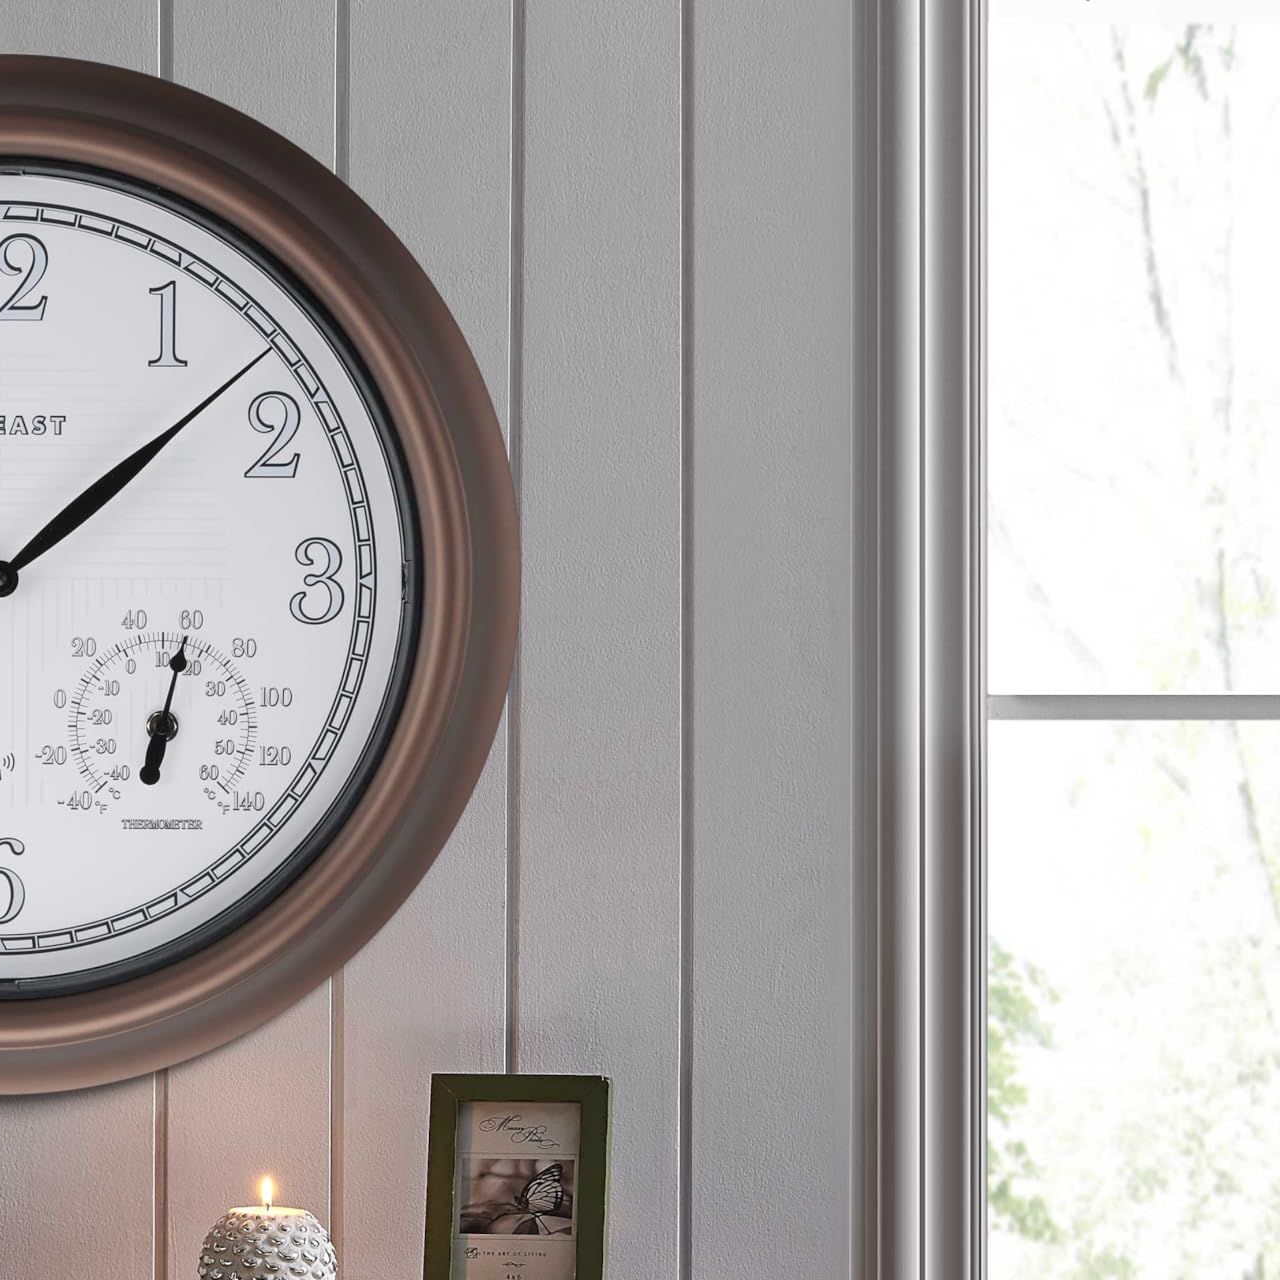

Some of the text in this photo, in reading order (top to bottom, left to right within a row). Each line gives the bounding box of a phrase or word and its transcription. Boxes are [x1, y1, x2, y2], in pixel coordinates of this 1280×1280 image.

[148, 281, 189, 367] 1
[245, 391, 302, 478] 2
[289, 537, 345, 624] 3
[121, 609, 147, 630] 40
[179, 609, 204, 630] 60
[71, 636, 97, 658] 20
[231, 638, 258, 658] 80
[125, 658, 137, 675] 0
[155, 651, 171, 668] 10
[182, 659, 202, 677] 20
[97, 679, 120, 696] -10
[205, 680, 226, 697] 30
[259, 687, 293, 708] 100
[53, 688, 67, 709] 0
[86, 709, 113, 725] -20
[217, 709, 238, 726] 40
[34, 745, 68, 766] -20
[89, 738, 117, 755] -30
[215, 739, 235, 756] 50
[258, 746, 292, 766] 120
[103, 764, 131, 781] -40
[199, 764, 220, 781] 60
[57, 790, 93, 811] -40
[232, 791, 265, 812] 140
[120, 818, 204, 831] THERMOMETER
